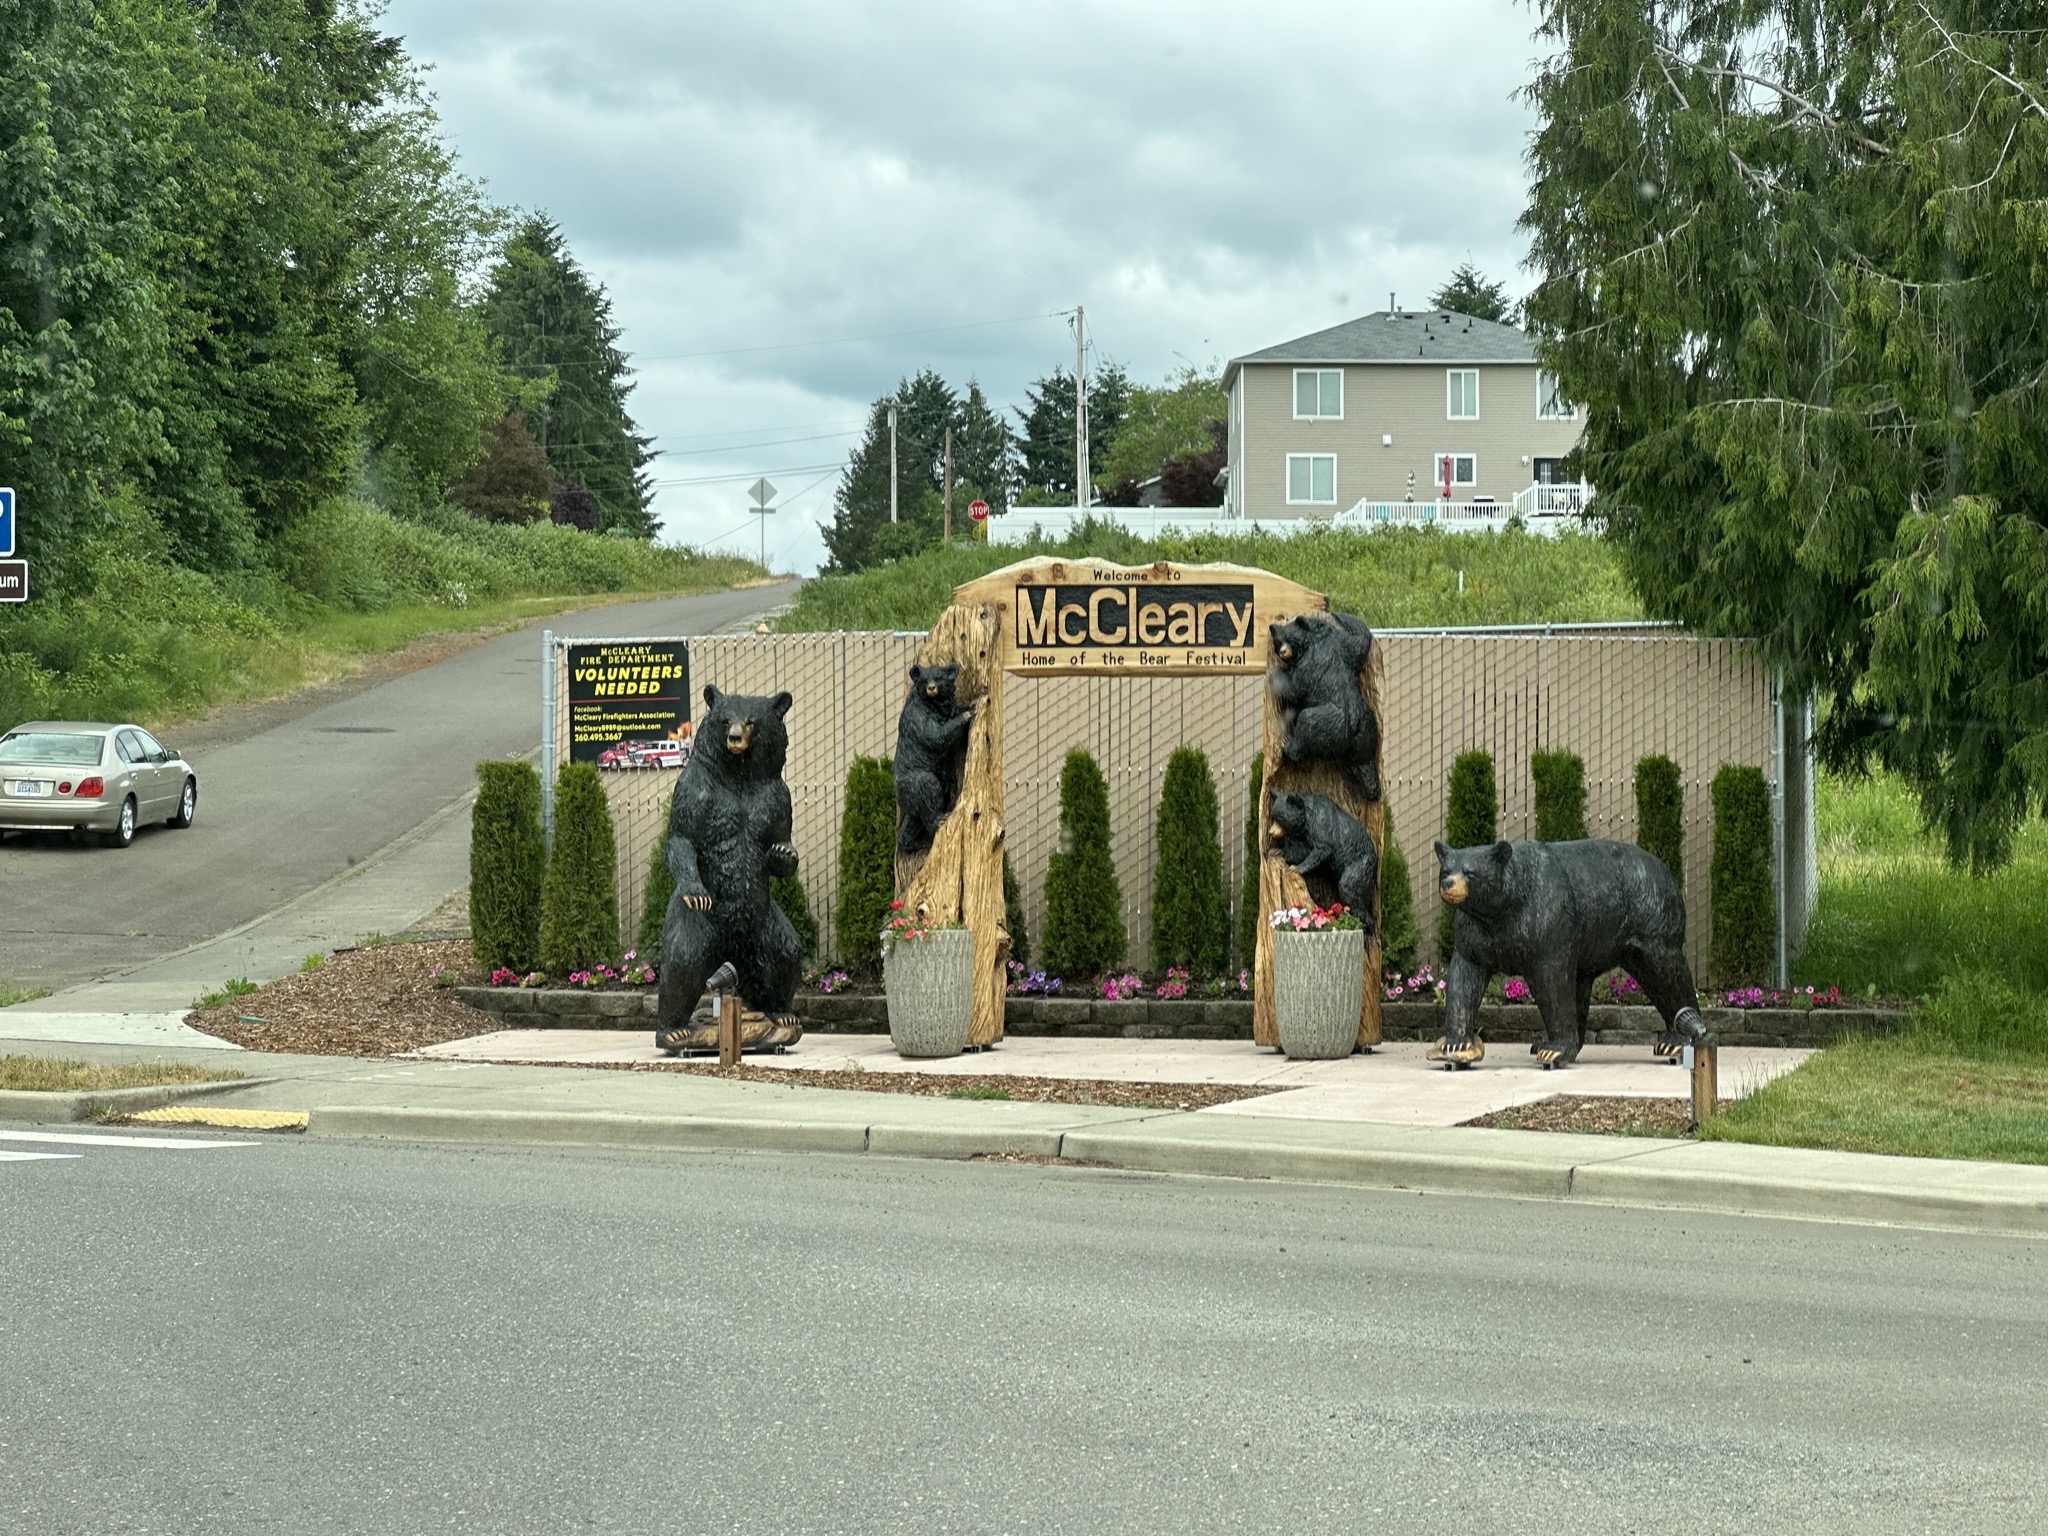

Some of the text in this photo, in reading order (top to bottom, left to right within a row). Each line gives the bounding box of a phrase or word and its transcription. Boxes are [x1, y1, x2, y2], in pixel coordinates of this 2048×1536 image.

[970, 506, 988, 516] STOP
[1093, 569, 1181, 581] Welcome to
[1017, 587, 1253, 647] McCleary
[601, 645, 651, 656] McCLEARY
[580, 653, 674, 665] FIRE DEPARTMENT
[1022, 652, 1246, 666] Home of the Bear Festival
[575, 665, 682, 682] VOLUNTEERS
[594, 681, 660, 696] NEEDED
[603, 713, 638, 721] Firefighters
[639, 711, 675, 719] Association
[574, 733, 622, 742] 360.495.3667
